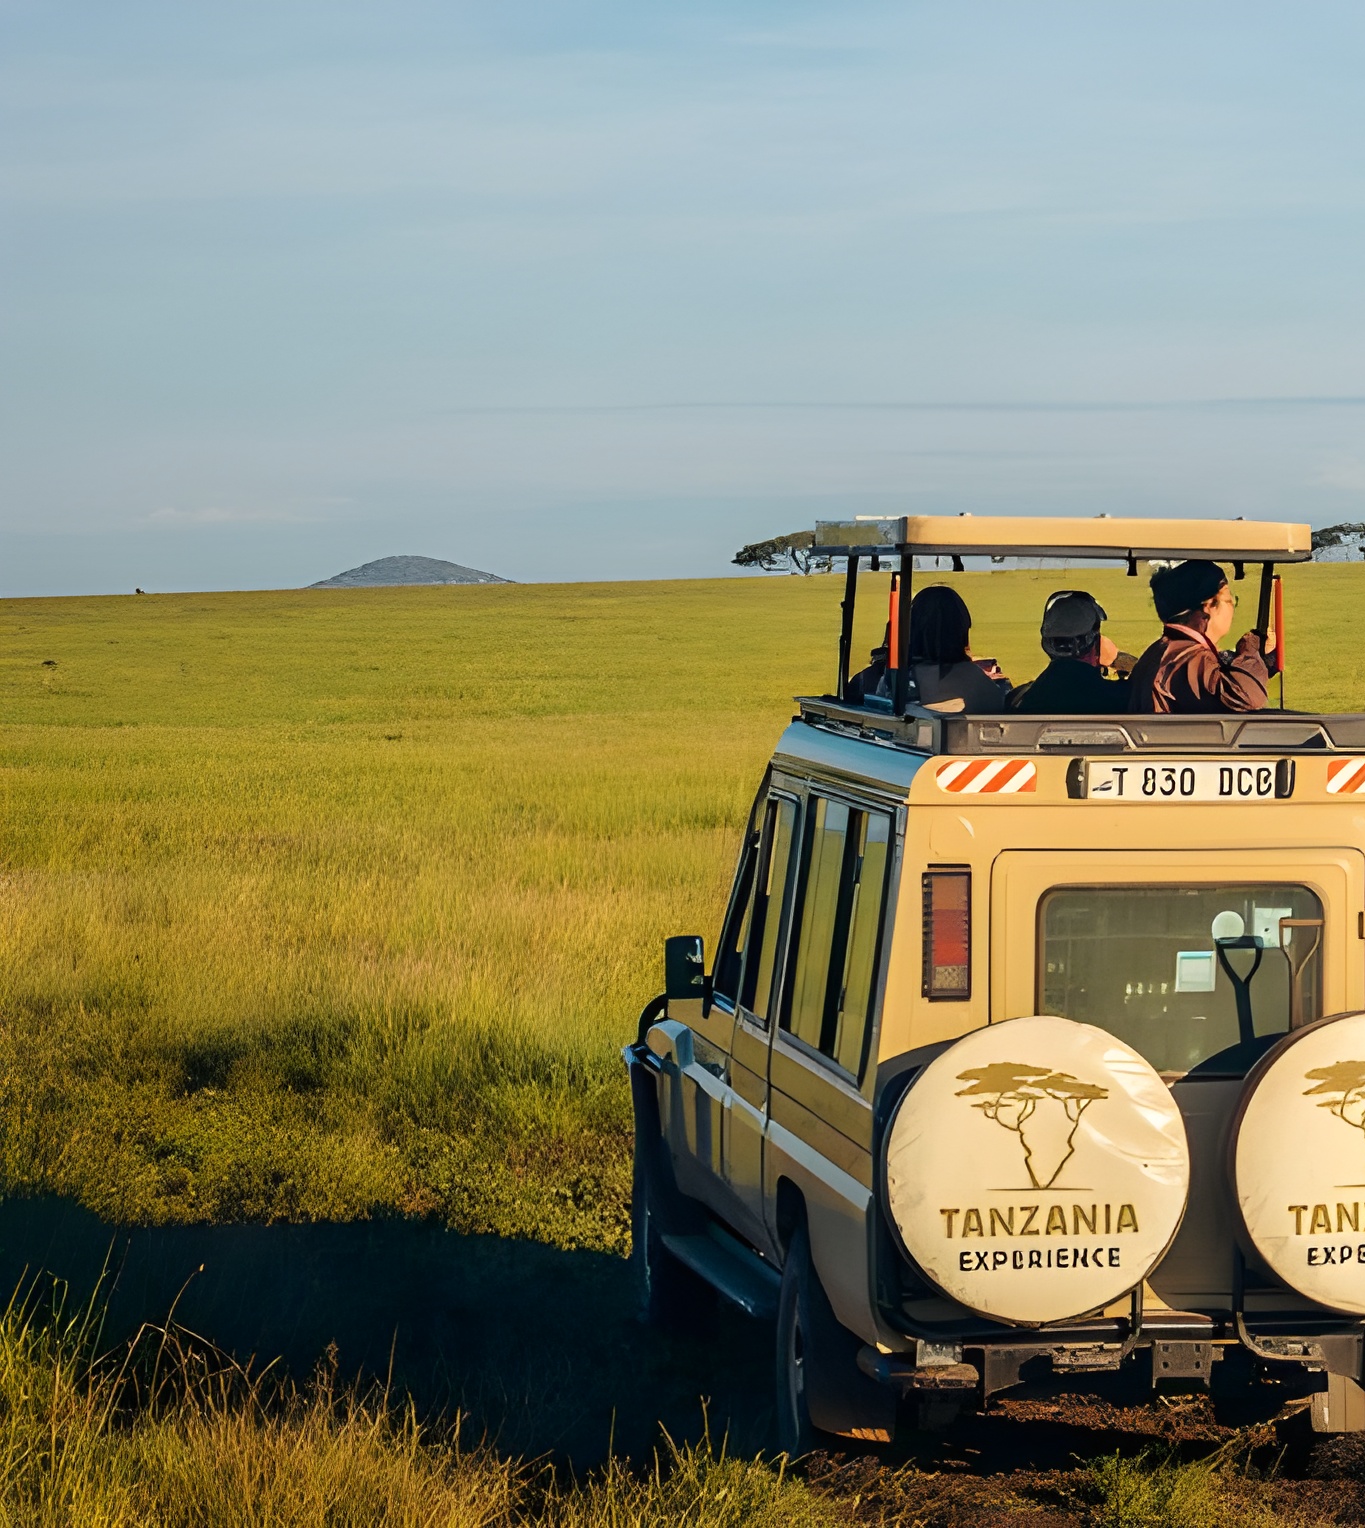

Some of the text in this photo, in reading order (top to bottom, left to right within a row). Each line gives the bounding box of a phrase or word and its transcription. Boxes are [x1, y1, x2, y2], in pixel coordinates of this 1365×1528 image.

[1112, 767, 1128, 796] T
[1142, 767, 1195, 796] 830
[939, 1203, 1139, 1239] TANZANIA
[959, 1248, 1121, 1272] EXPERIENCE
